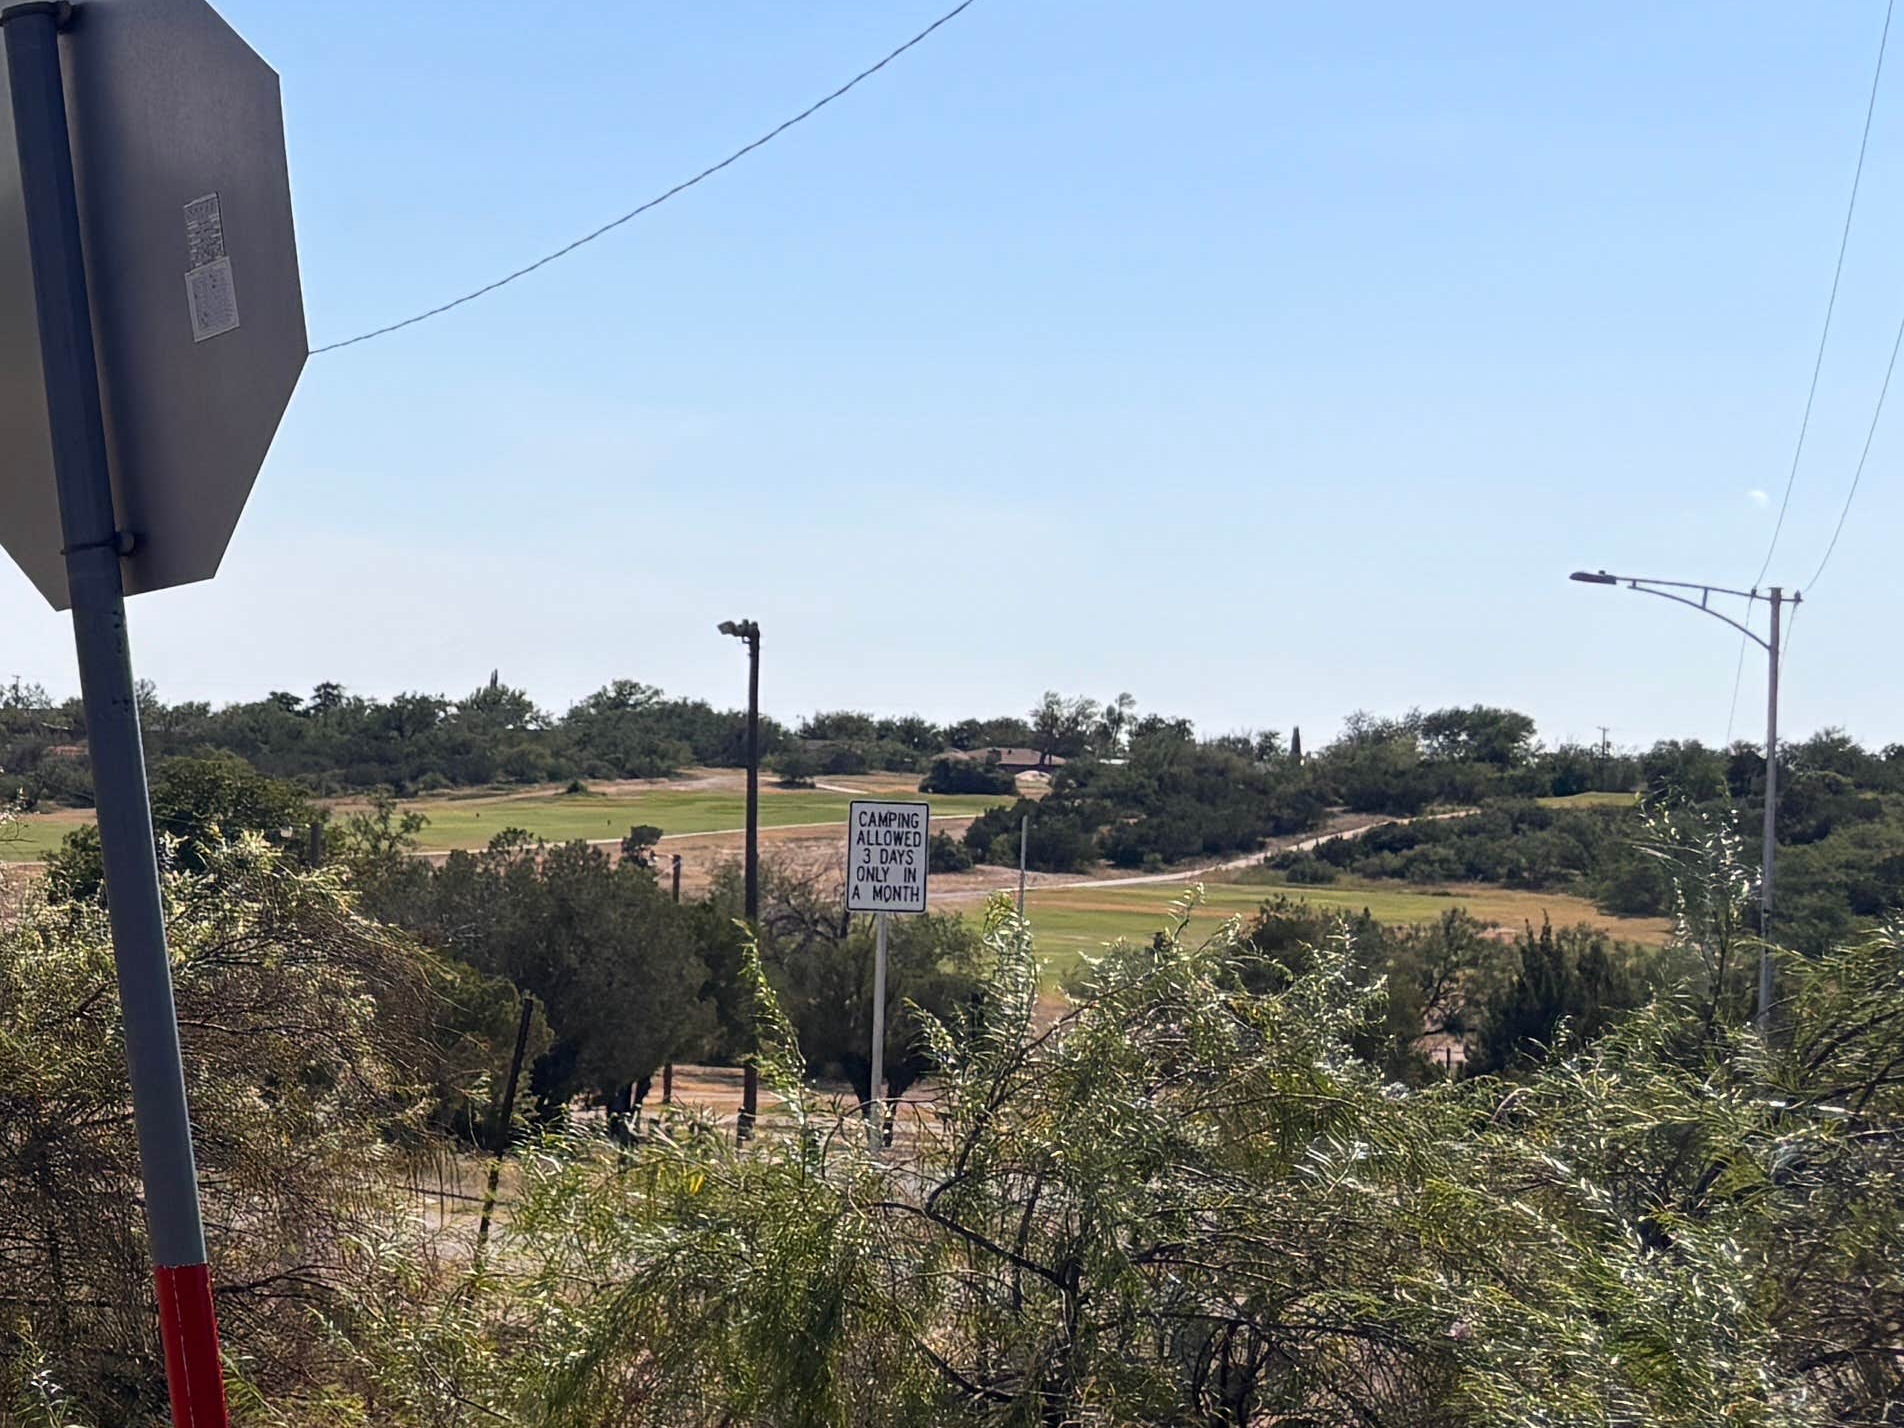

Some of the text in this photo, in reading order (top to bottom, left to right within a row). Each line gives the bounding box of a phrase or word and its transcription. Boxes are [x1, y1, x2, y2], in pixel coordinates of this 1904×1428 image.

[859, 811, 920, 828] CAMPING
[856, 830, 921, 847] ALLOWED
[863, 848, 914, 865] 3 DAYS
[857, 866, 916, 883] ONLY IN
[852, 885, 920, 902] A MONTH
